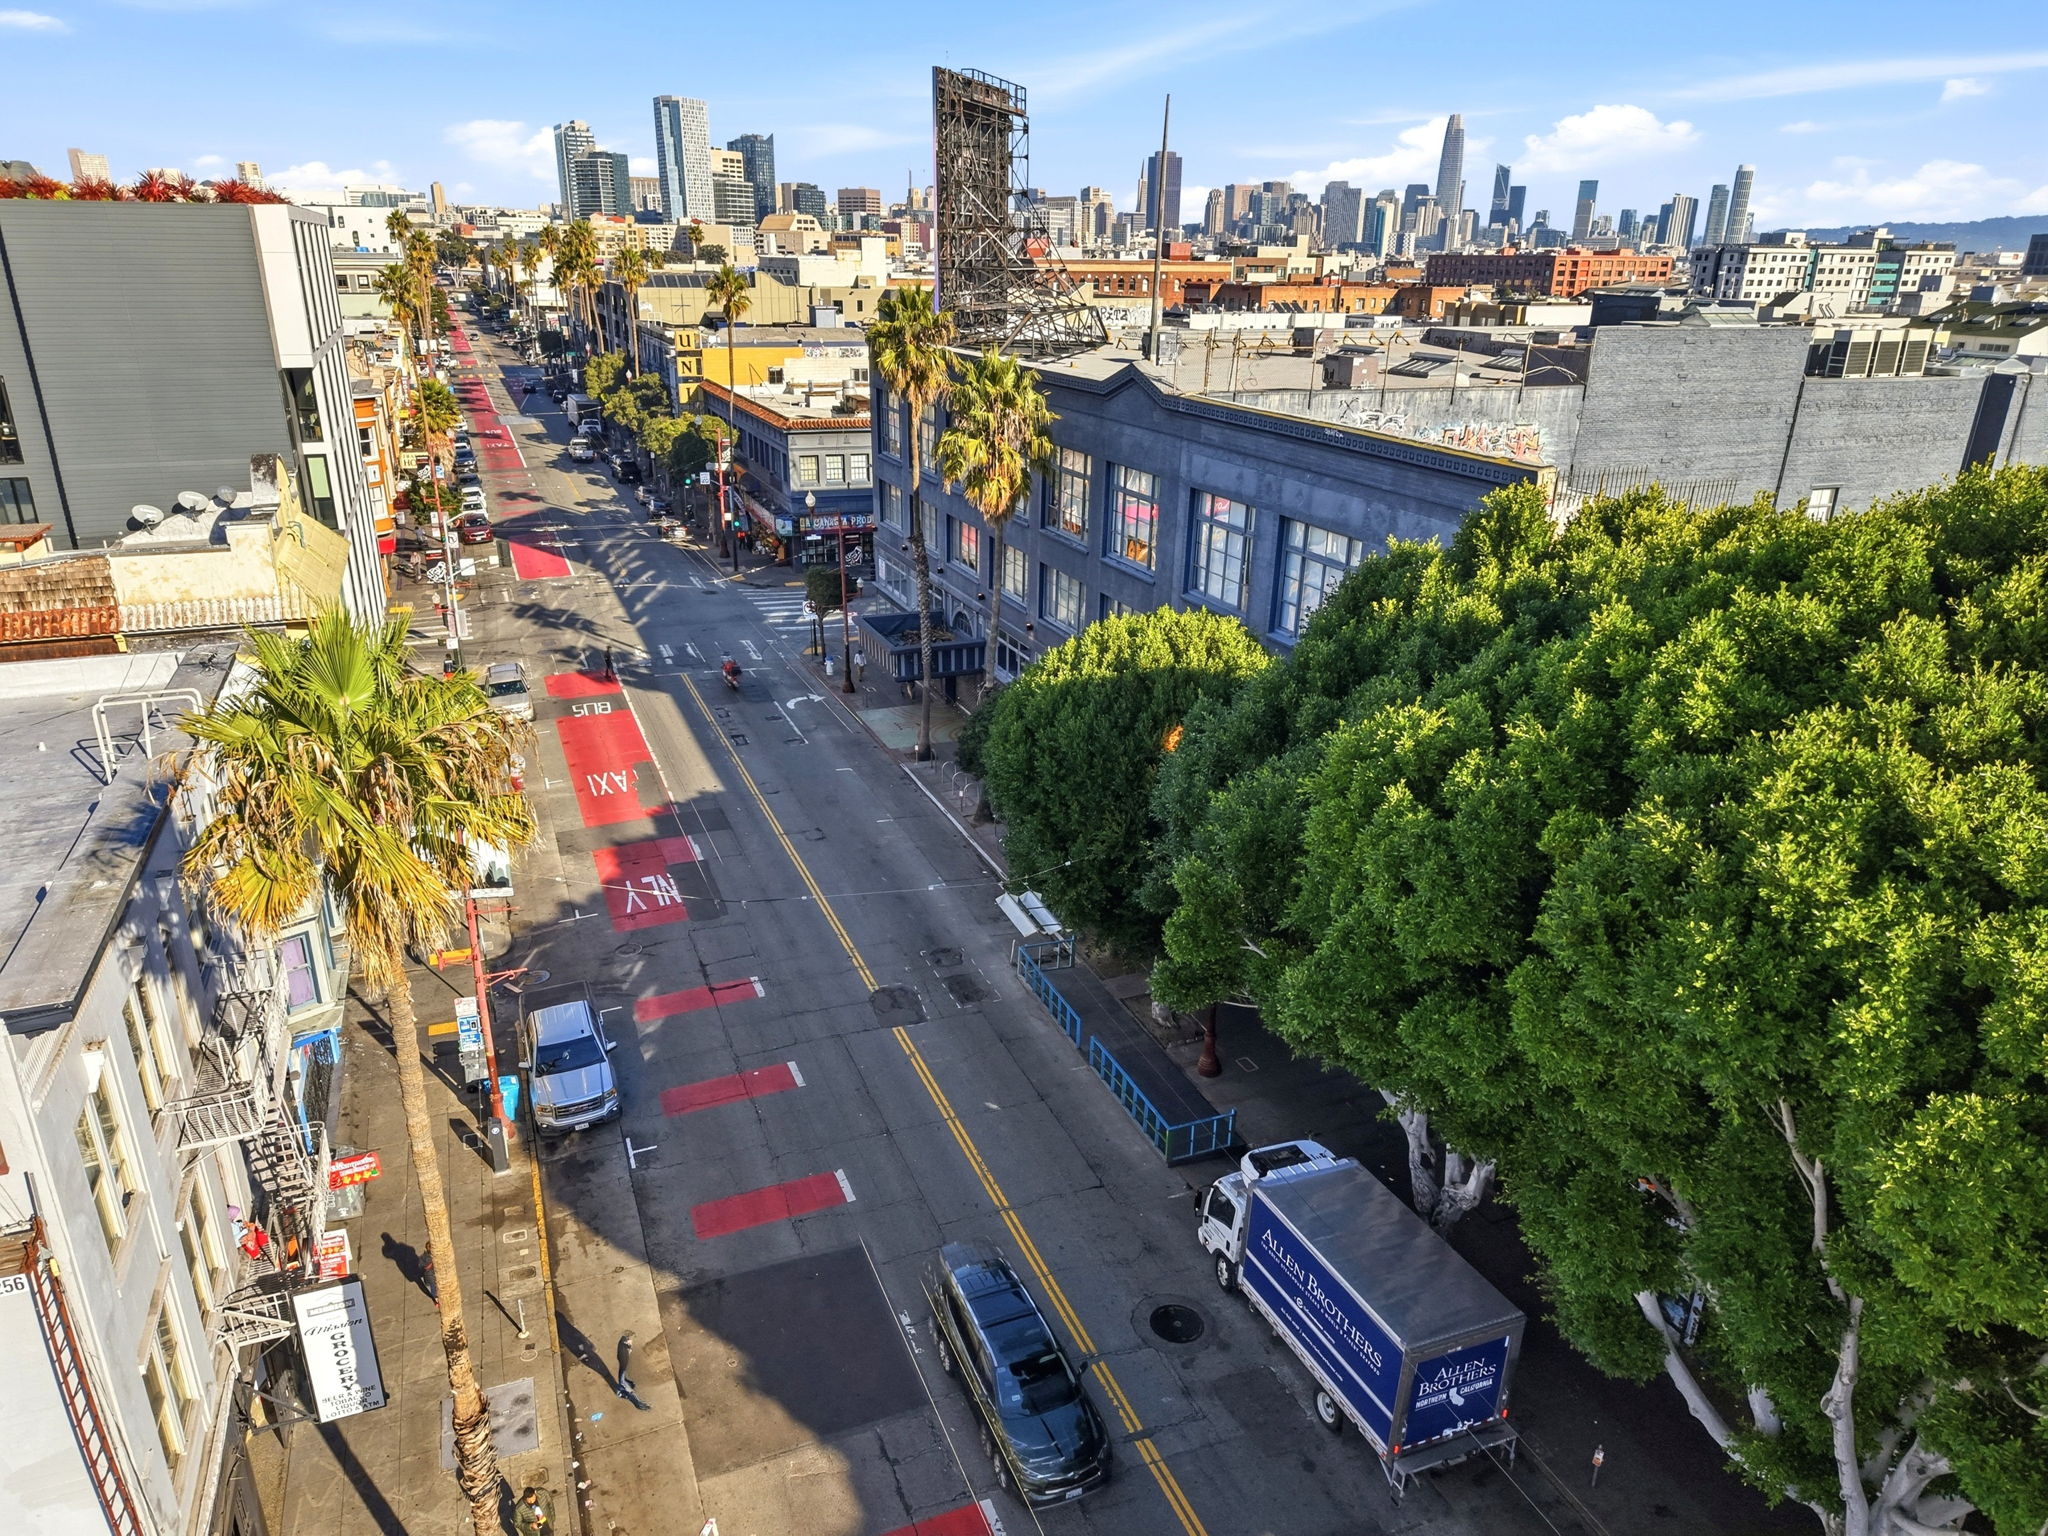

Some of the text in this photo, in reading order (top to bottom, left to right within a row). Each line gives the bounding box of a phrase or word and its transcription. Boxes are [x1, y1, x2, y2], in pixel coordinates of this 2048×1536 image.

[571, 701, 612, 718] BUS
[586, 769, 639, 797] AXI
[1261, 1229, 1305, 1282] ALLEN
[1307, 1272, 1383, 1368] BROTHERS
[304, 1318, 363, 1337] Mission
[330, 1331, 356, 1391] GROCERY
[1434, 1357, 1485, 1382] ALLEN
[1418, 1363, 1497, 1396] BROTHERS
[330, 1391, 372, 1407] TOBACCO
[335, 1397, 368, 1411] LIQUOR
[1415, 1378, 1493, 1408] NORTHERN CALIFORNIA
[325, 1407, 353, 1419] LOTTO
[362, 1400, 380, 1409] ATM
